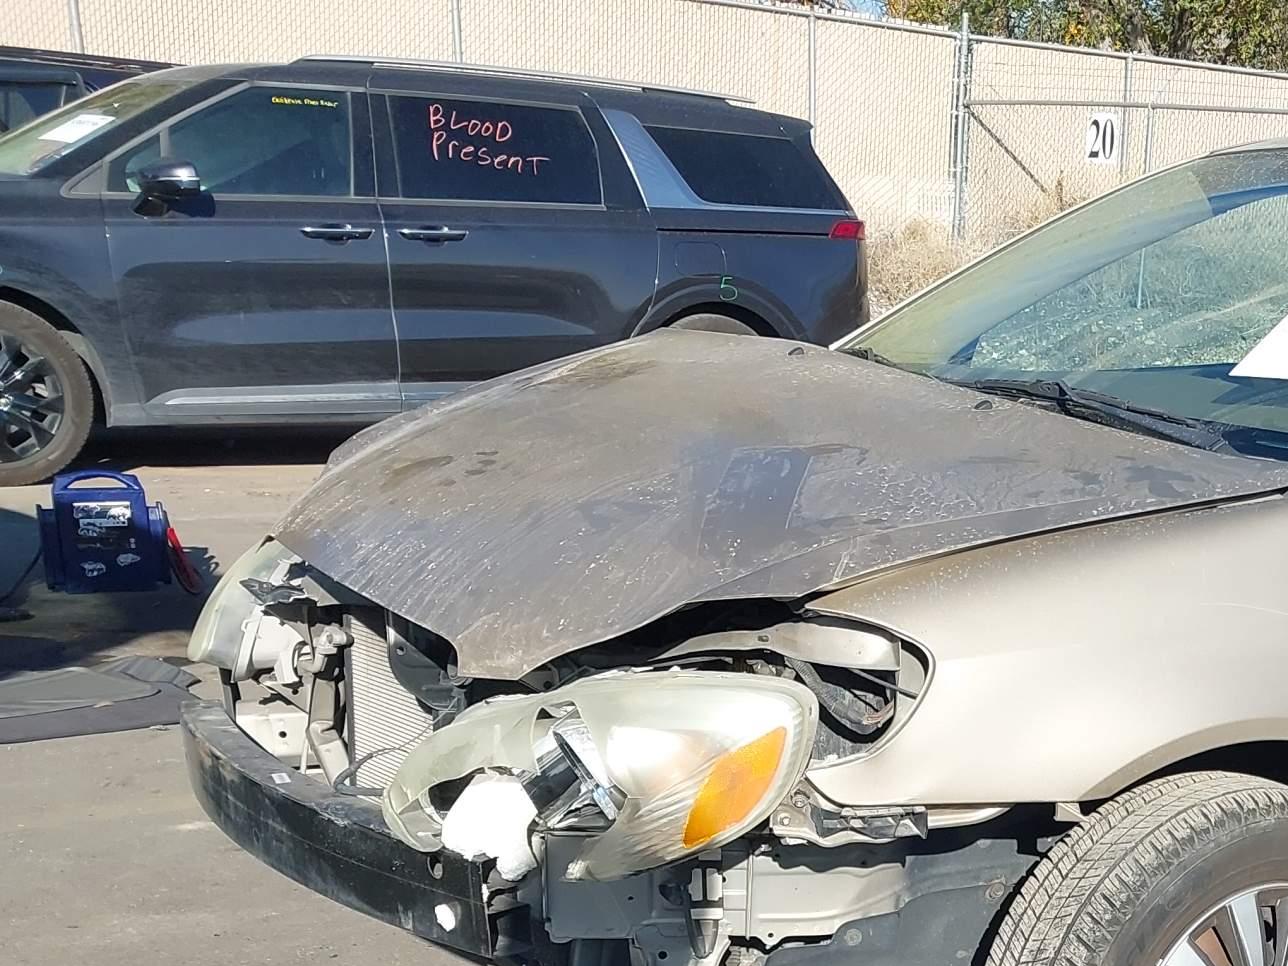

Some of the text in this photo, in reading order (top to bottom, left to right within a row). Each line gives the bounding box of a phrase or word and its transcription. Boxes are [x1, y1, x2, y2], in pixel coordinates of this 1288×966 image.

[429, 103, 512, 142] BLOOD
[1088, 118, 1115, 160] 20
[719, 276, 738, 301] 5
